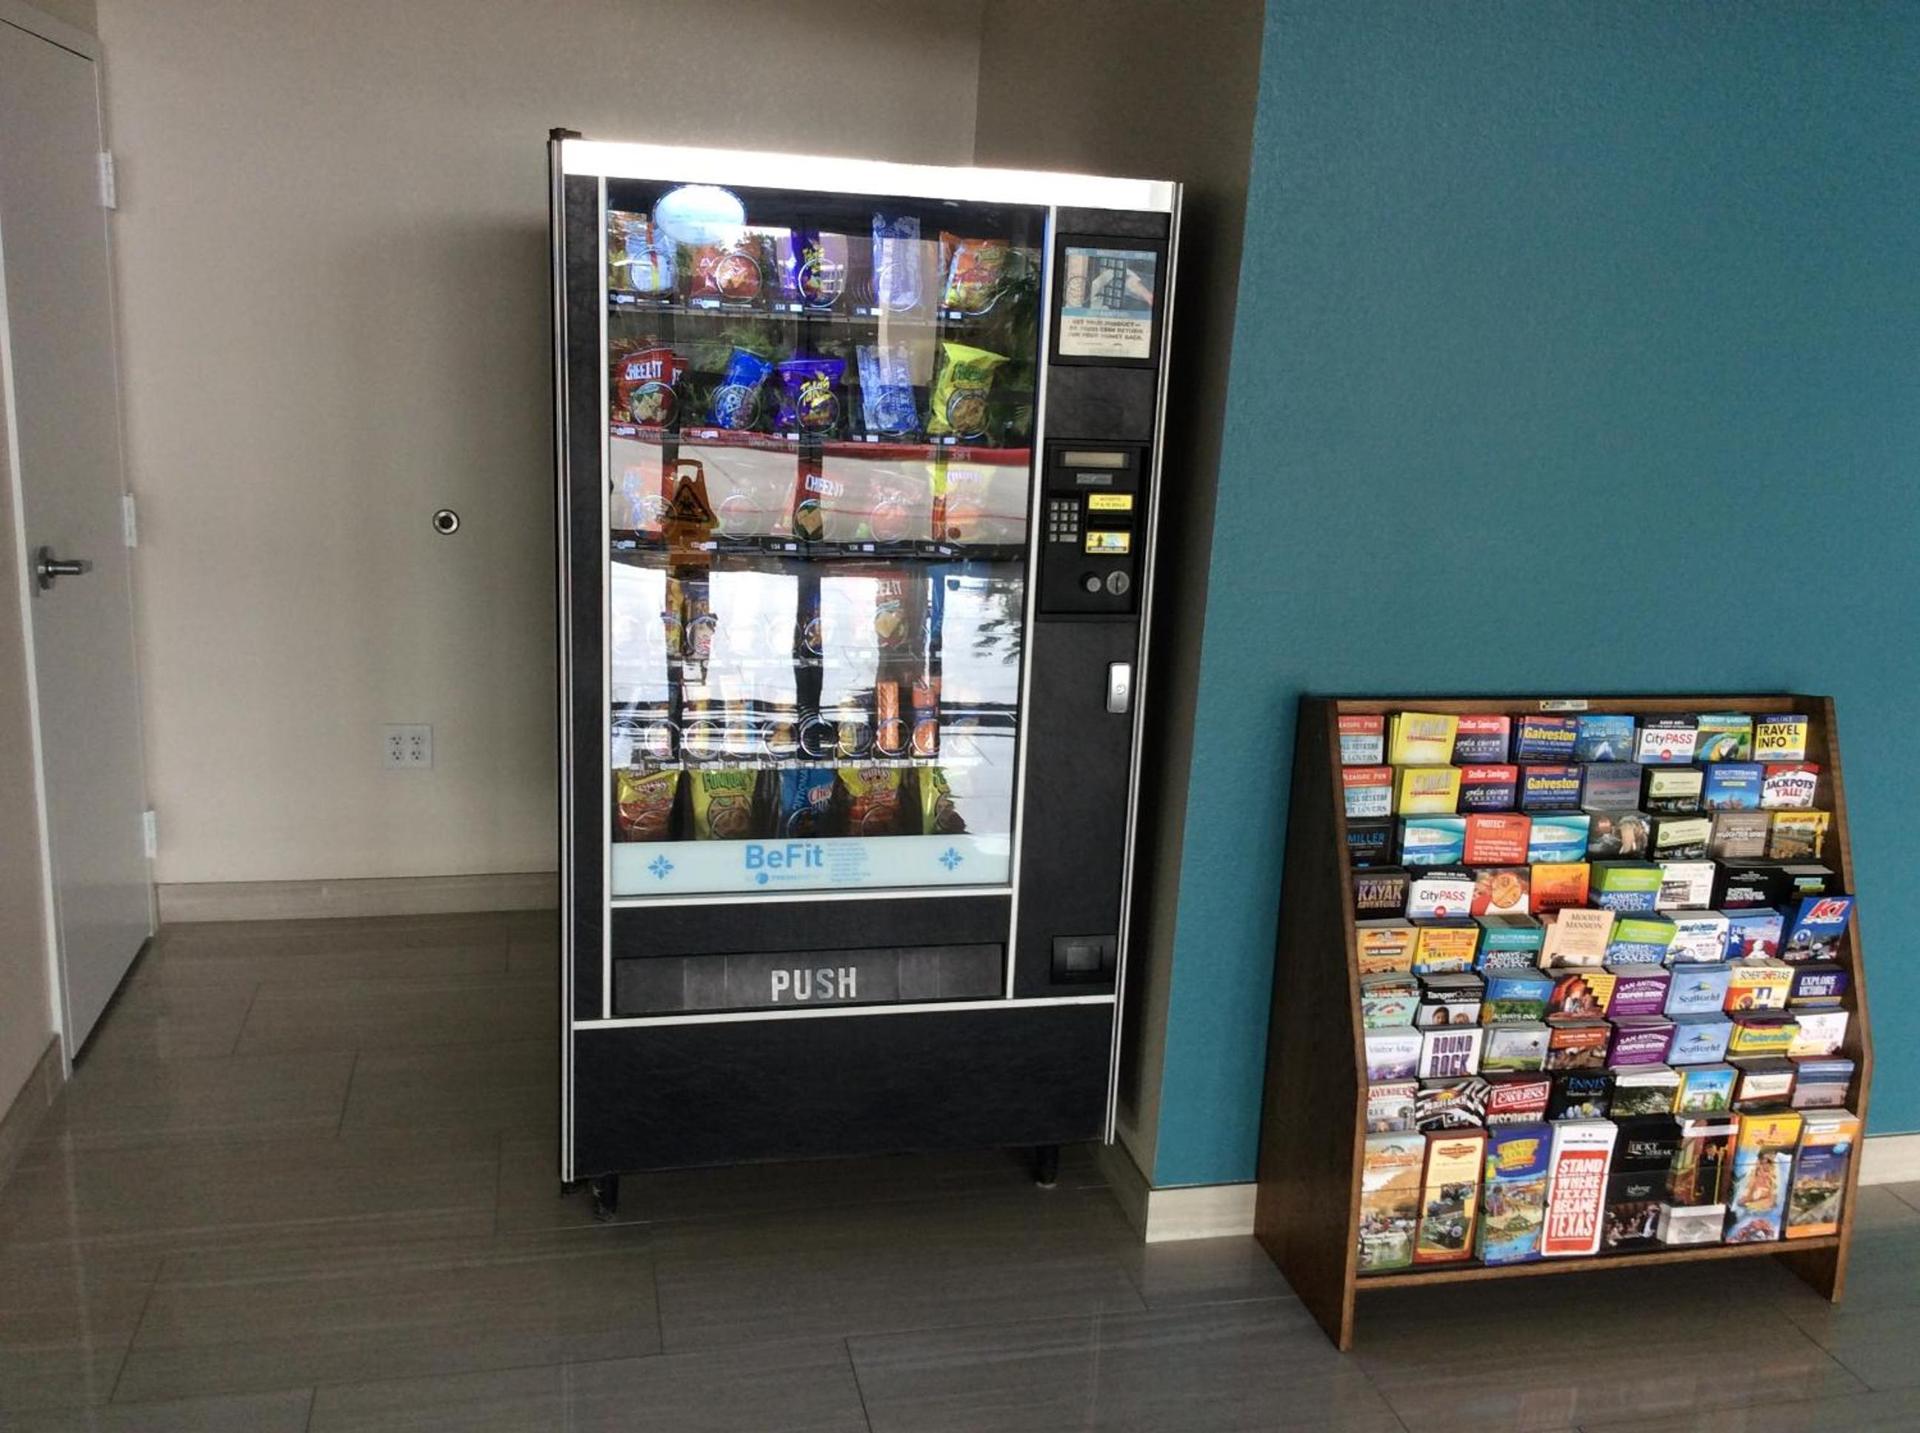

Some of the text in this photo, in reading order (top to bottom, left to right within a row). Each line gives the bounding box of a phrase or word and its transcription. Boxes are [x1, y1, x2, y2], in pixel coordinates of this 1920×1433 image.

[1524, 727, 1577, 741] Galveston
[1757, 724, 1800, 737] TRAVEL
[1645, 732, 1693, 747] CityPASS
[1757, 736, 1787, 748] INFO
[1527, 777, 1580, 791] Galveston
[1765, 778, 1815, 791] JACKPOTS
[1346, 831, 1386, 844] MILLER
[745, 843, 824, 869] BeFit
[1358, 885, 1403, 901] KAYAK
[1419, 889, 1466, 904] CityPASS
[770, 966, 857, 1001] PUSH
[1800, 976, 1837, 986] EXPLORE
[1679, 993, 1720, 1003] SeaWorld
[1431, 1035, 1473, 1054] ROUND
[1679, 1043, 1720, 1053] SeaWorld
[1429, 1054, 1470, 1078] ROCK
[1568, 1077, 1607, 1089] ENNIS
[1559, 1158, 1604, 1173] STAND
[1557, 1176, 1601, 1190] WHERE
[1555, 1189, 1599, 1199] TEXAS
[1552, 1199, 1598, 1214] BECAME
[1550, 1214, 1596, 1238] TEXAS
